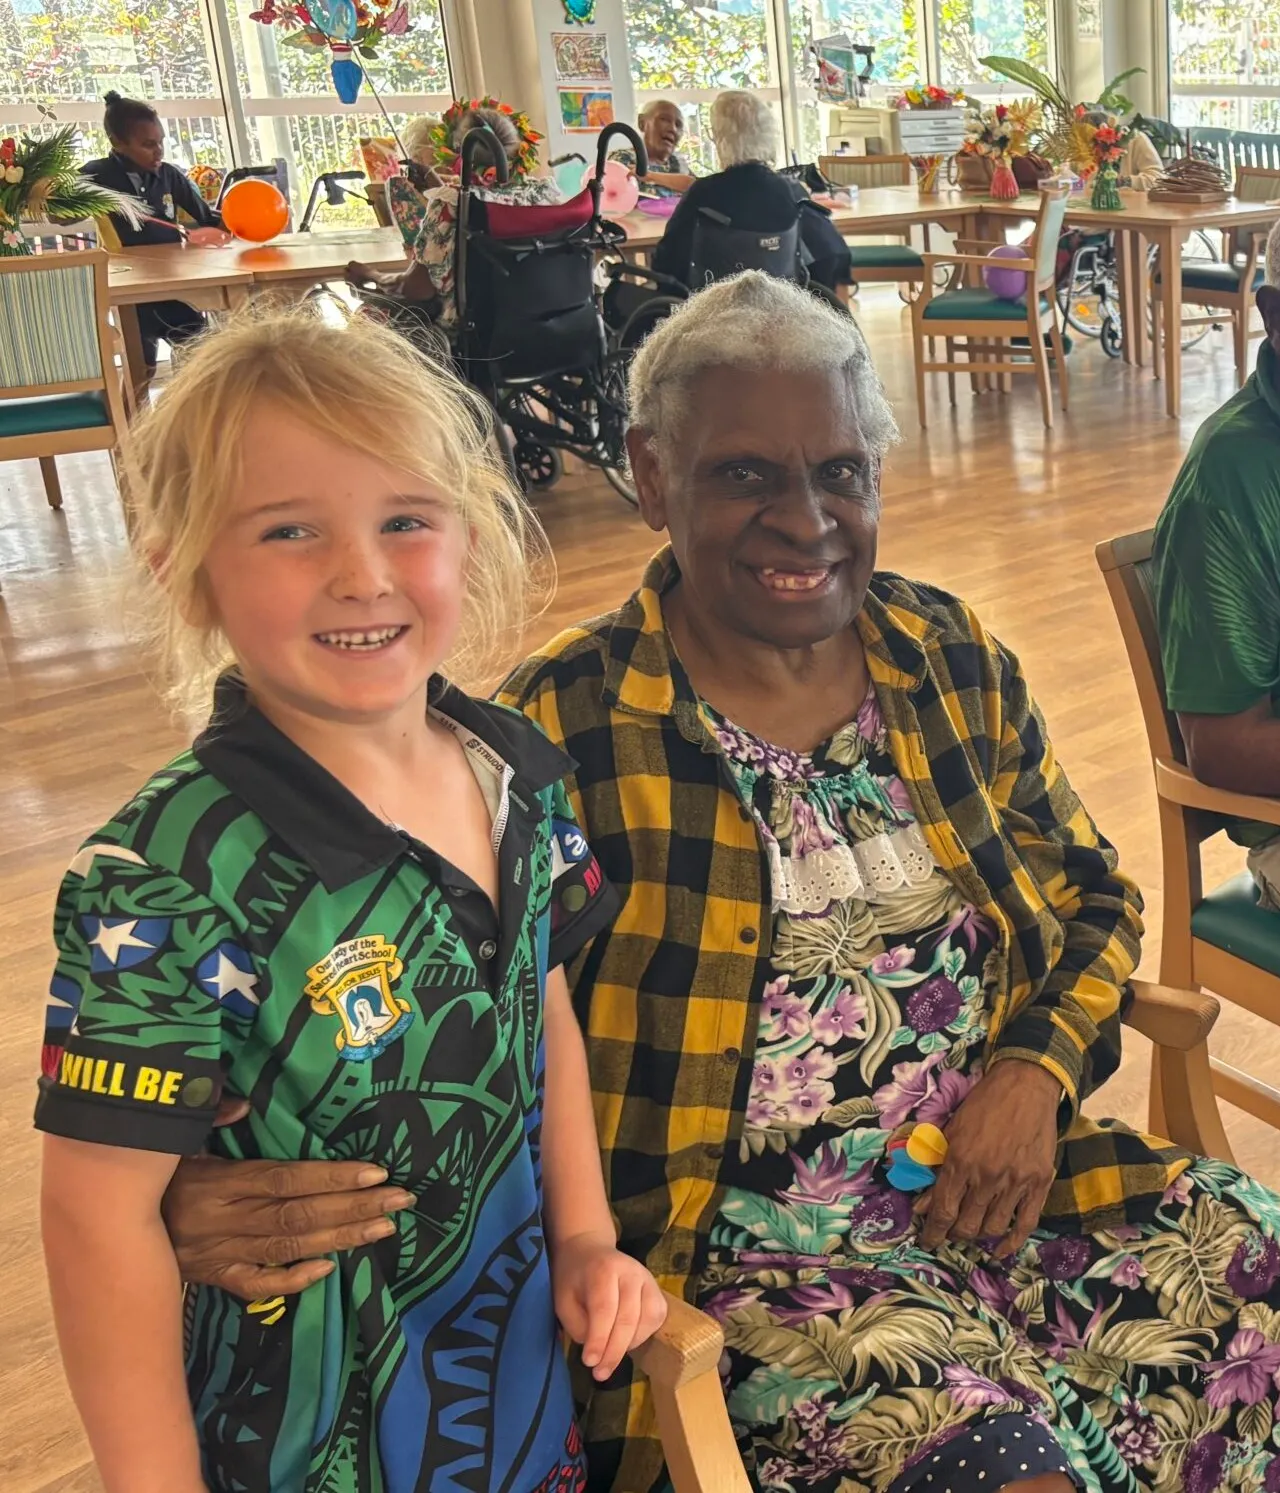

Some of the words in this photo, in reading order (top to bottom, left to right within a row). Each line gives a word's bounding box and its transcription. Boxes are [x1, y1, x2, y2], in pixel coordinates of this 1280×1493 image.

[310, 967, 337, 993] Sacred
[335, 953, 358, 971] Heart
[359, 948, 392, 960] School
[316, 958, 333, 974] Our
[332, 945, 348, 961] Lady
[349, 940, 359, 952] of
[360, 938, 377, 948] the
[344, 977, 356, 987] FOR
[359, 967, 381, 981] JESUS
[60, 1052, 125, 1096] WILL
[133, 1066, 184, 1105] BE
